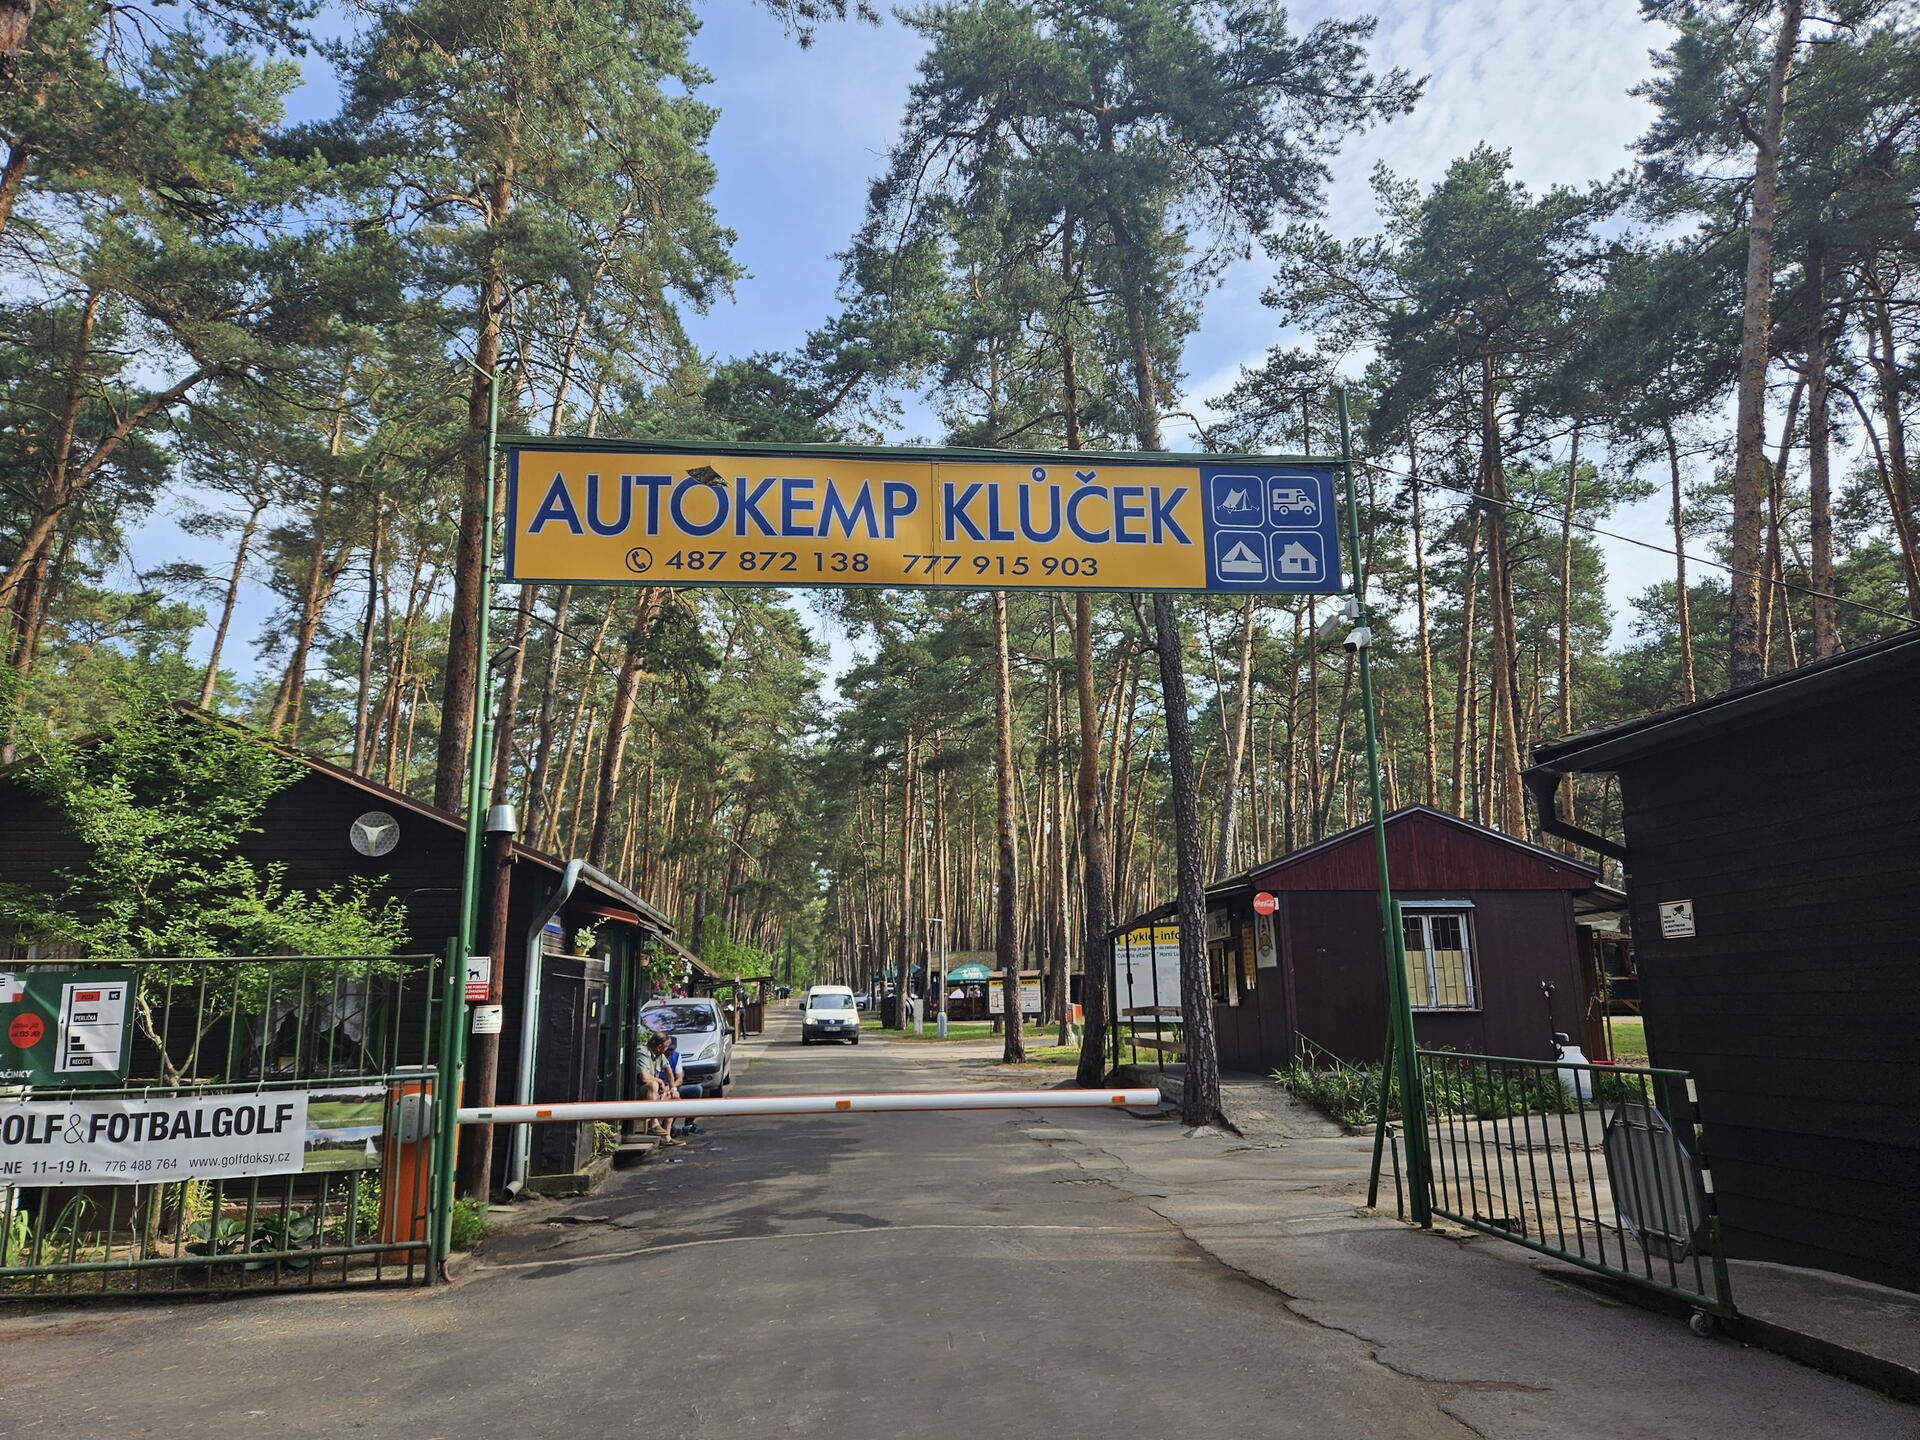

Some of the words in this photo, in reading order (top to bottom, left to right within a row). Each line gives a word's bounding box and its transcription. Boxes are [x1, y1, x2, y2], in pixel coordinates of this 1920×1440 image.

[526, 471, 919, 541] AUTOKEMP
[943, 466, 1195, 547] KLŮČEK
[665, 550, 727, 571] 487
[739, 551, 796, 571] 872
[813, 552, 868, 572] 138
[901, 554, 962, 575] 777
[972, 556, 1029, 576] 915
[1041, 557, 1099, 577] 903
[0, 1103, 294, 1144] OLF&FOTBALGOLF
[79, 1159, 92, 1173] h.
[104, 1160, 127, 1172] 776
[130, 1159, 152, 1171] 488
[156, 1158, 177, 1170] 764
[188, 1151, 291, 1168] www.golfdoksy.cz
